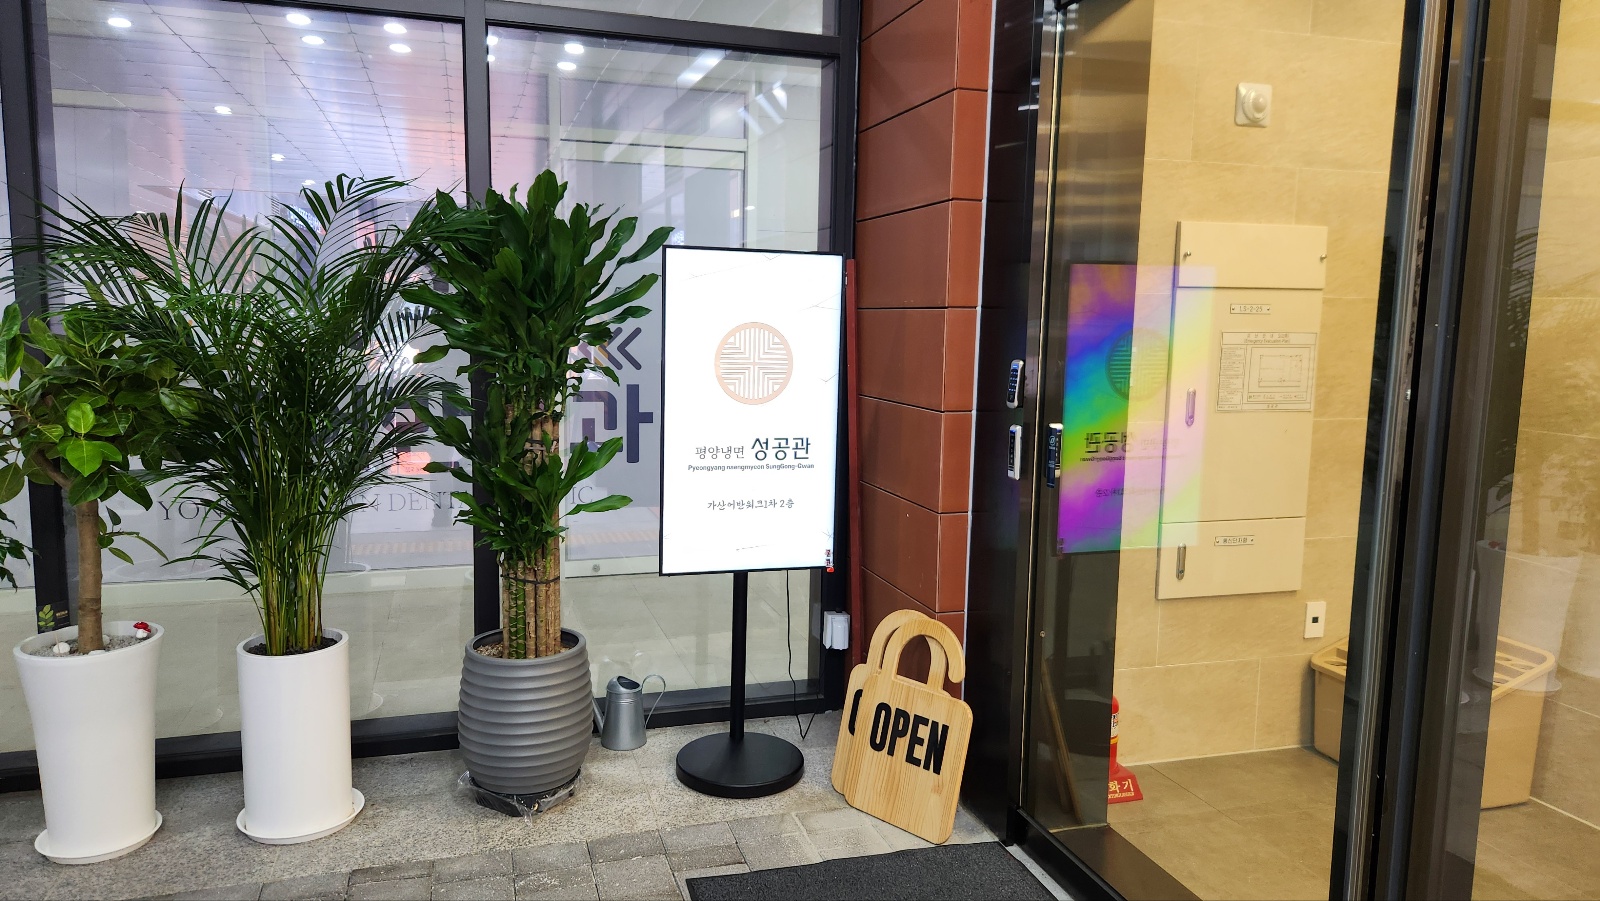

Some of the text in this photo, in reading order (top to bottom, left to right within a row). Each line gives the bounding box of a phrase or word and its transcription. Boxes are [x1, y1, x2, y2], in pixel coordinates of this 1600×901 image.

[694, 436, 812, 461] 평양냉면 성공관
[687, 464, 726, 473] Pyeongyang
[779, 497, 795, 509] 2층
[869, 702, 950, 776] OPEN
